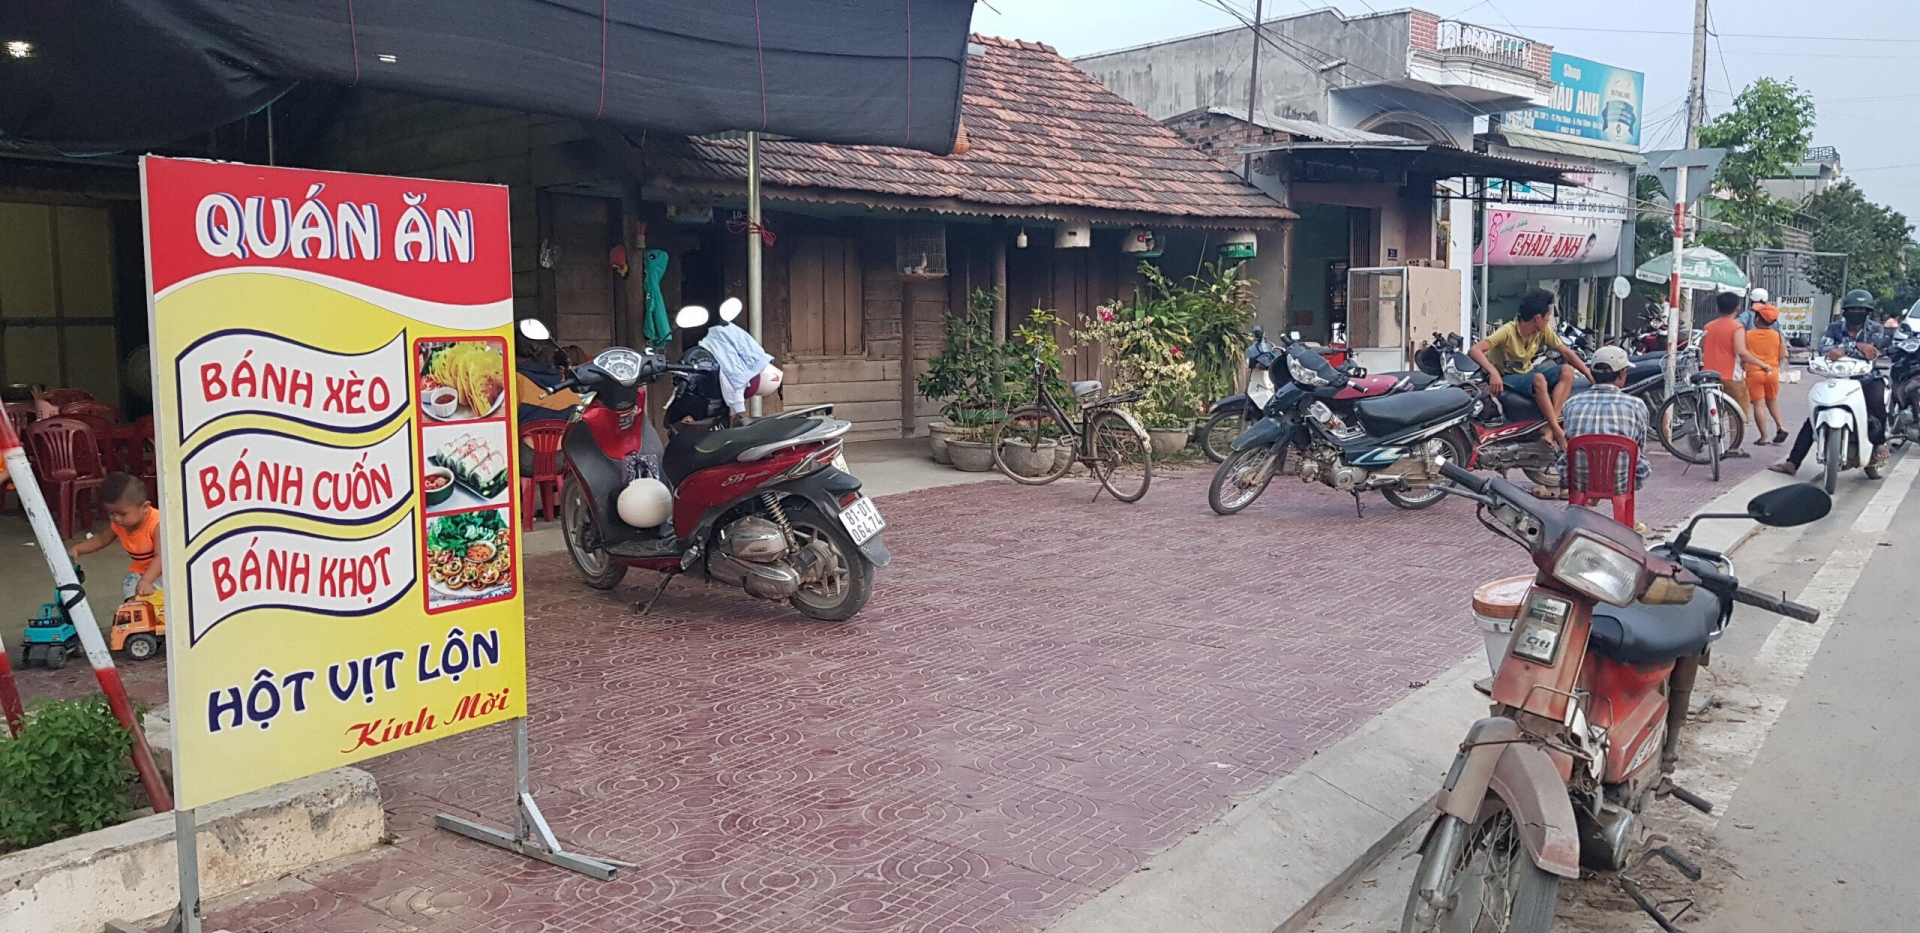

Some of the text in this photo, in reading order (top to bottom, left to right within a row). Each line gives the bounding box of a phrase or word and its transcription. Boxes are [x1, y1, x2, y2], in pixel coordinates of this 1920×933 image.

[1549, 82, 1574, 112] HÂU
[1575, 90, 1600, 117] ANH
[1563, 63, 1582, 81] Shop
[195, 182, 475, 263] QUÁN ĂN
[1548, 236, 1584, 259] ANH
[200, 349, 391, 414] BÁNH XÈO
[199, 448, 393, 511] BÁNH CUỐN
[852, 512, 884, 542] 064.74
[211, 536, 391, 604] BÁNH KHỌT
[208, 627, 500, 733] HỘT VỊT LỘN
[341, 688, 510, 754] Kính Mời
